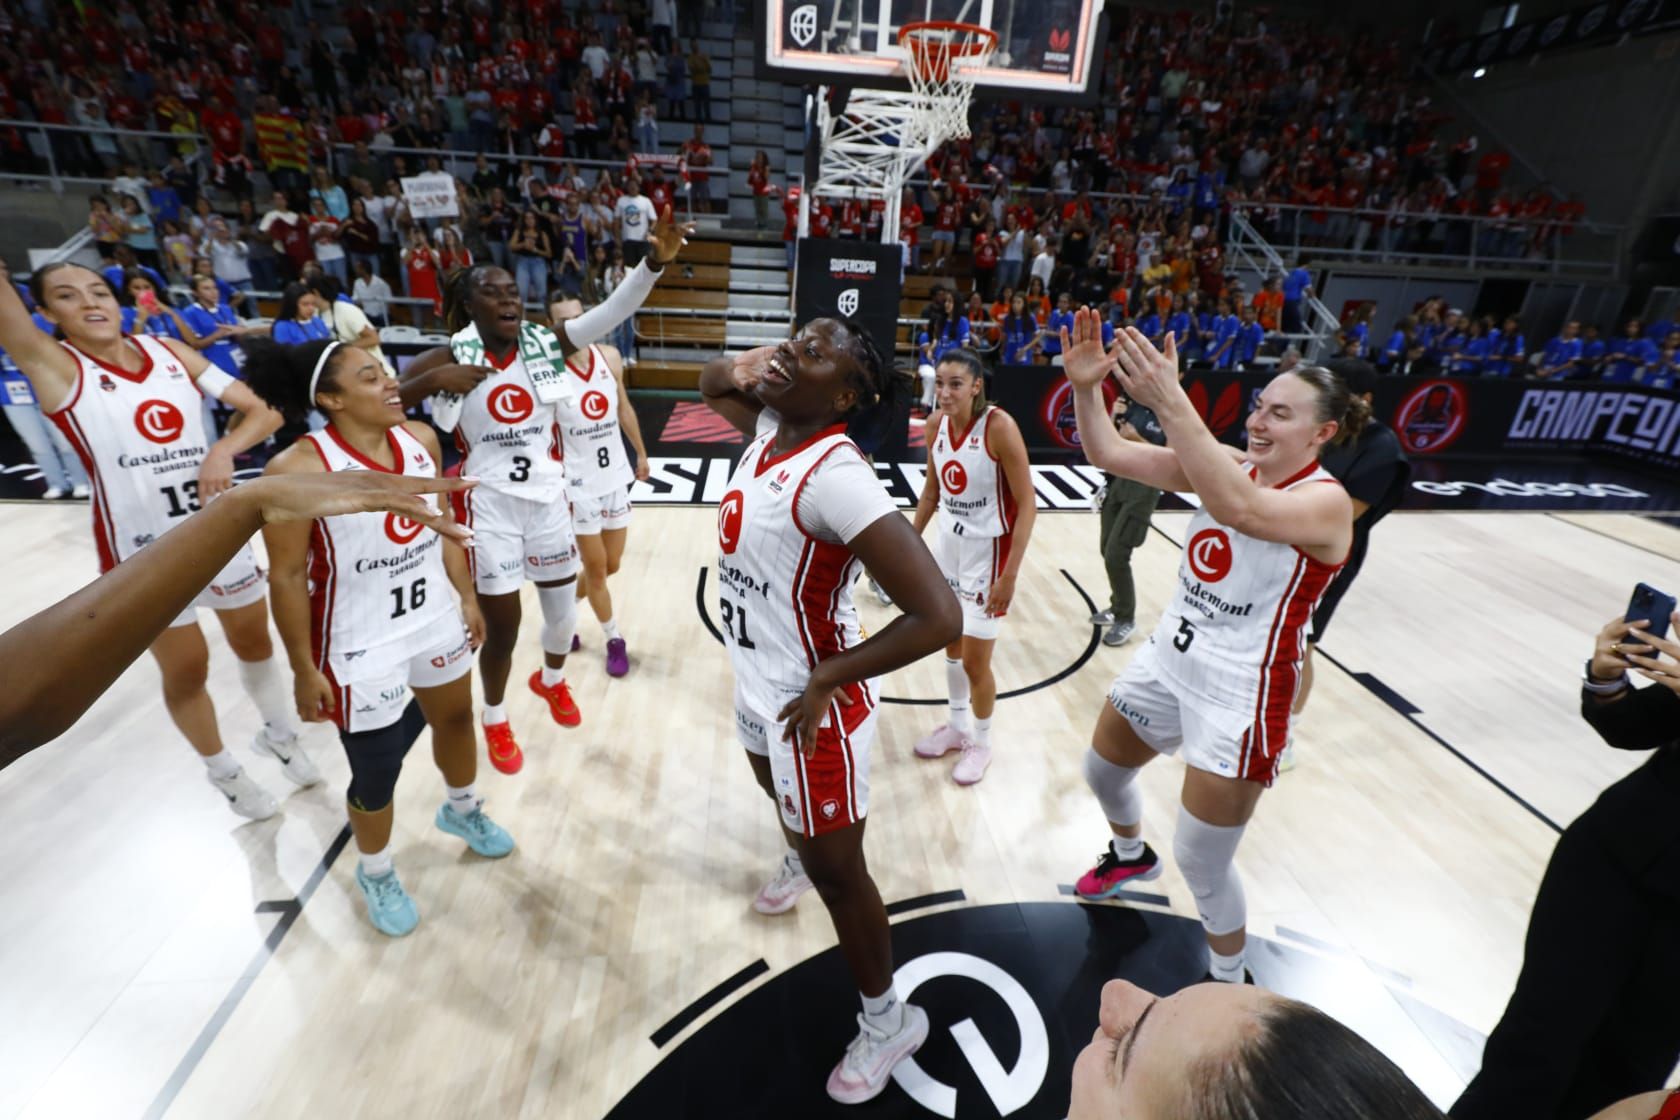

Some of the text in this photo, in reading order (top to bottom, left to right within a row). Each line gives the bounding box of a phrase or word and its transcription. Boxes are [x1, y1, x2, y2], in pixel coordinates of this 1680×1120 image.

[509, 456, 532, 483] 3
[597, 446, 610, 469] 8
[390, 577, 427, 620] 16
[1173, 615, 1198, 654] 5
